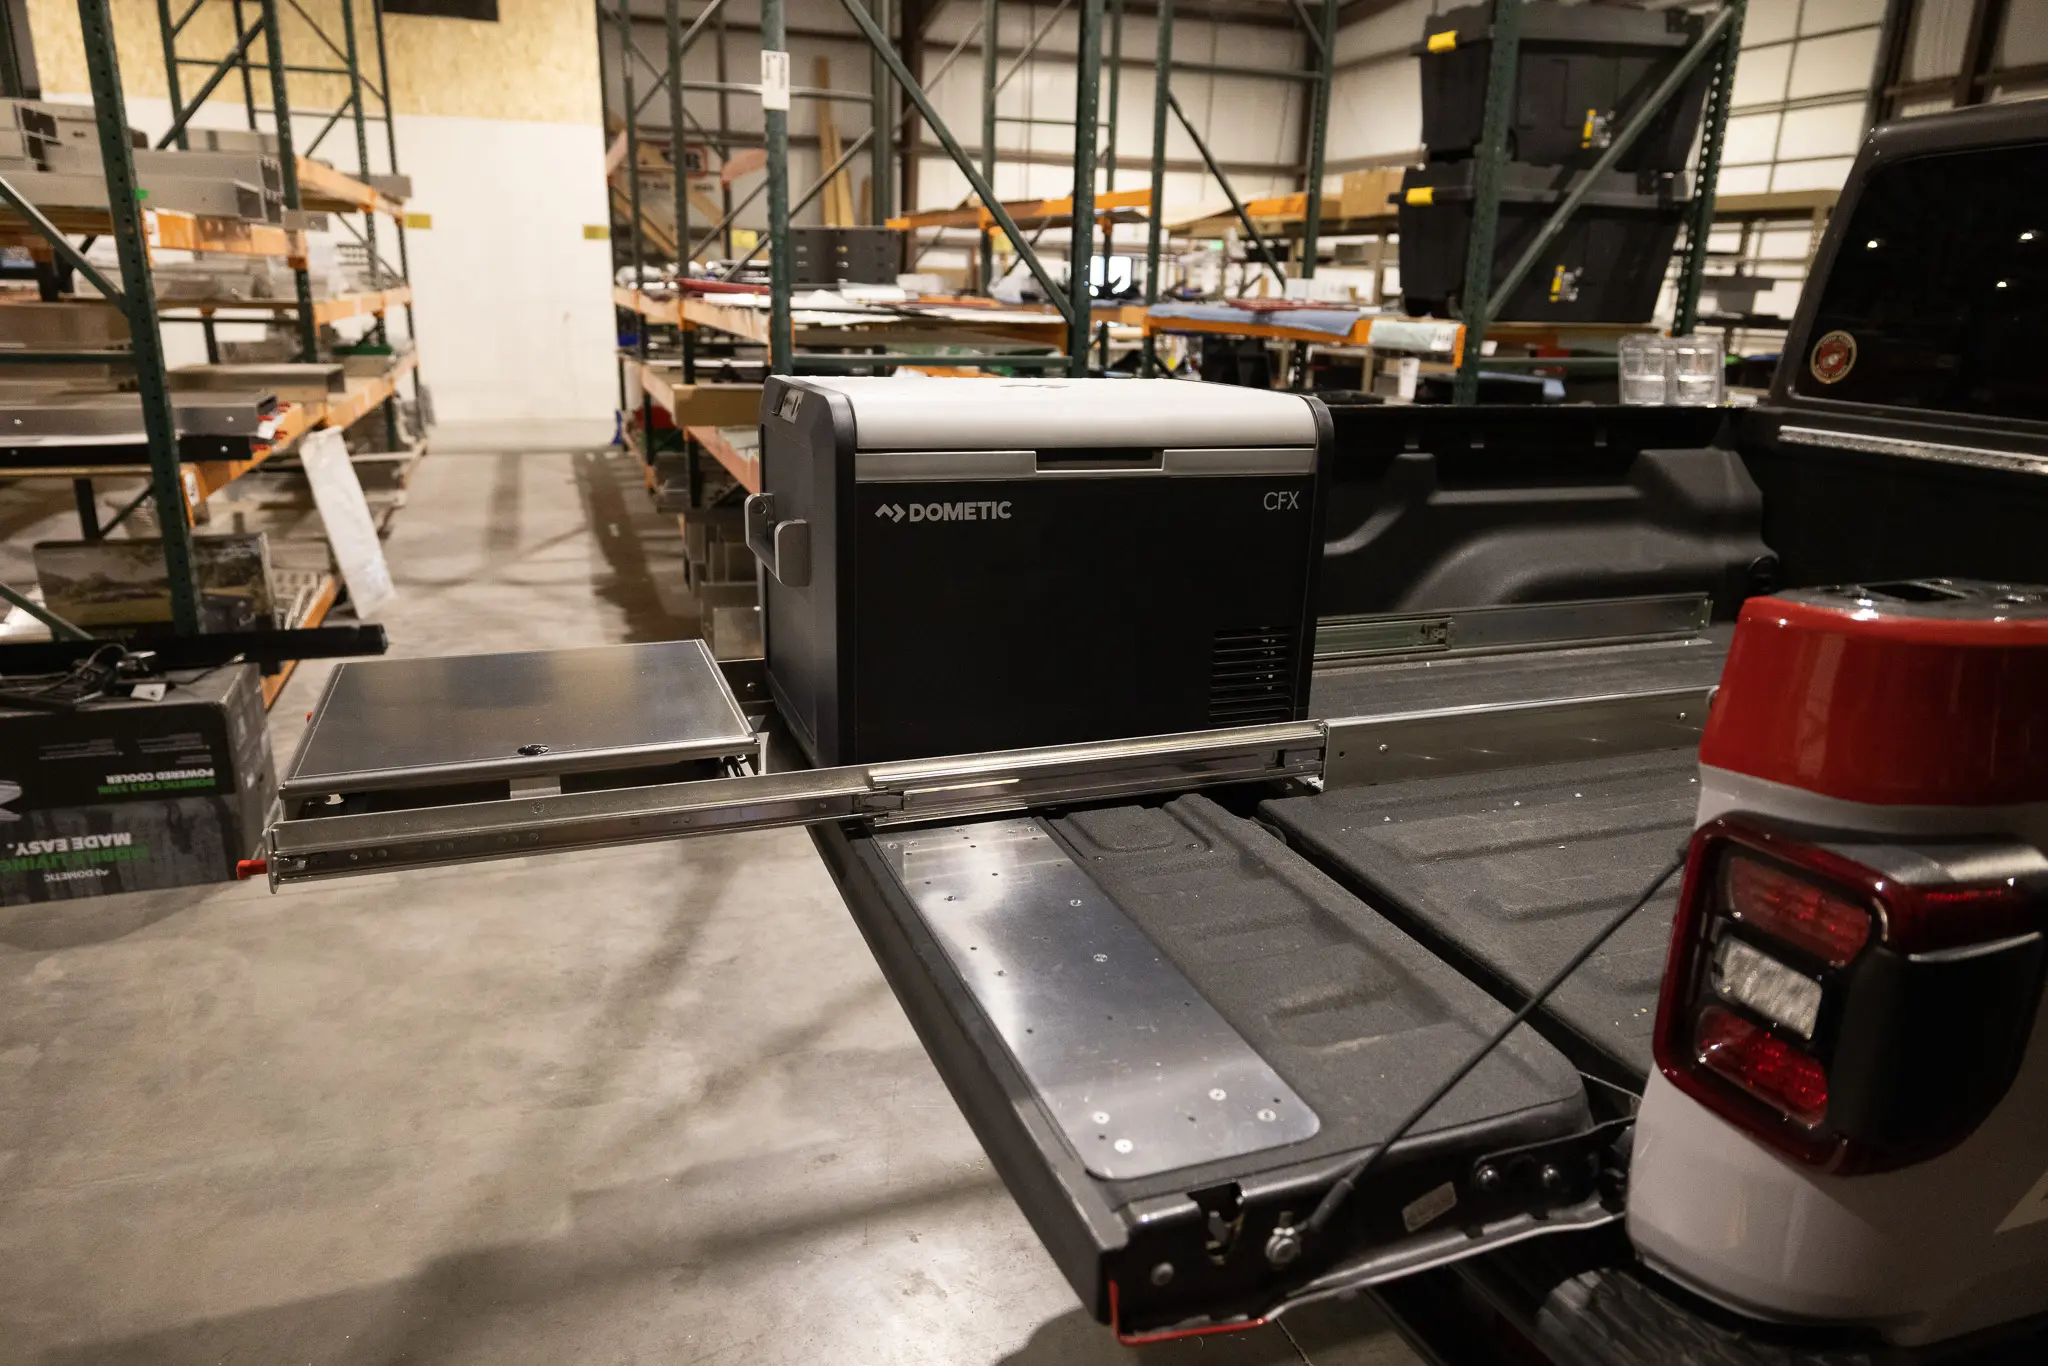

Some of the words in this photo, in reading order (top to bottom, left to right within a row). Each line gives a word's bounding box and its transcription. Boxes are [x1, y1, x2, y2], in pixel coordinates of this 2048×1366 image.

[1264, 491, 1300, 511] CFX
[909, 500, 1012, 522] DOMETIC
[106, 772, 155, 784] COOLER
[156, 768, 215, 781] POWERED
[7, 838, 68, 857] EASY.
[71, 832, 132, 851] MADE
[43, 869, 94, 883] DOMETIC
